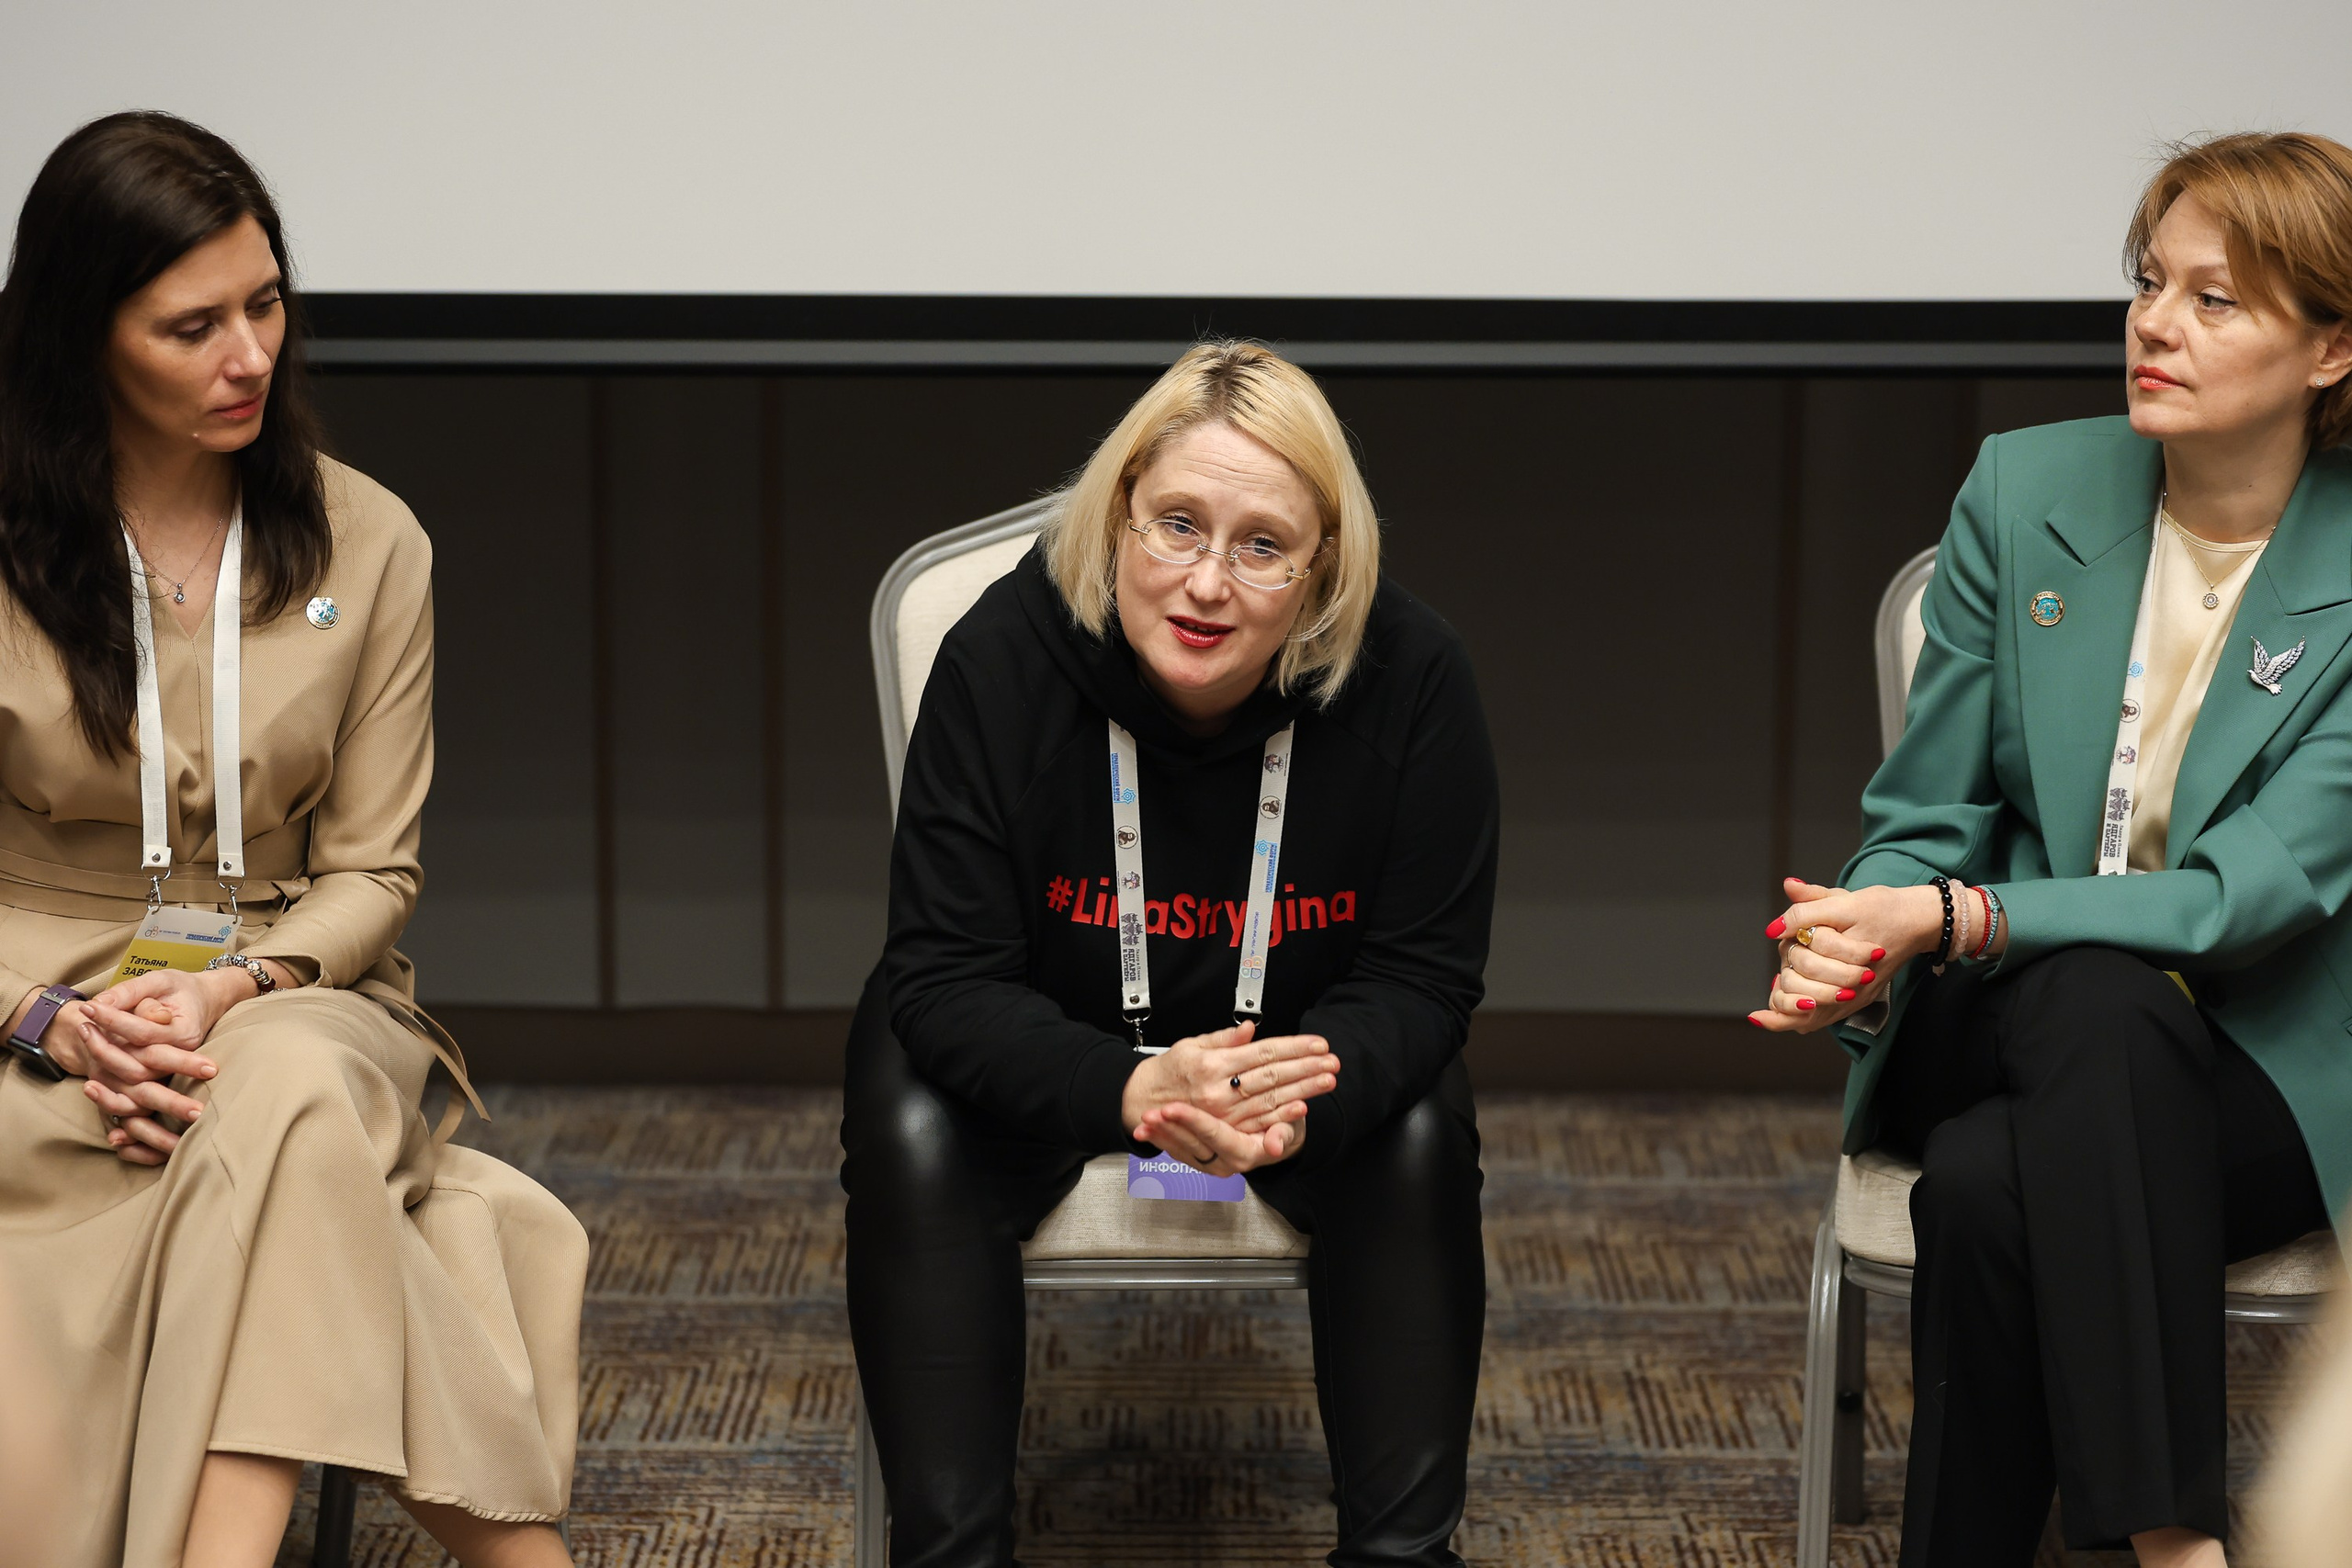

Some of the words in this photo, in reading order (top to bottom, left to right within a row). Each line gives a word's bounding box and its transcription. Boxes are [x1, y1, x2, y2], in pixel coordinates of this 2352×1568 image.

[2109, 823, 2118, 857] ЯДГАРОВ
[130, 955, 168, 967] Татьяна
[1139, 1161, 1203, 1174] ИНФОПА
